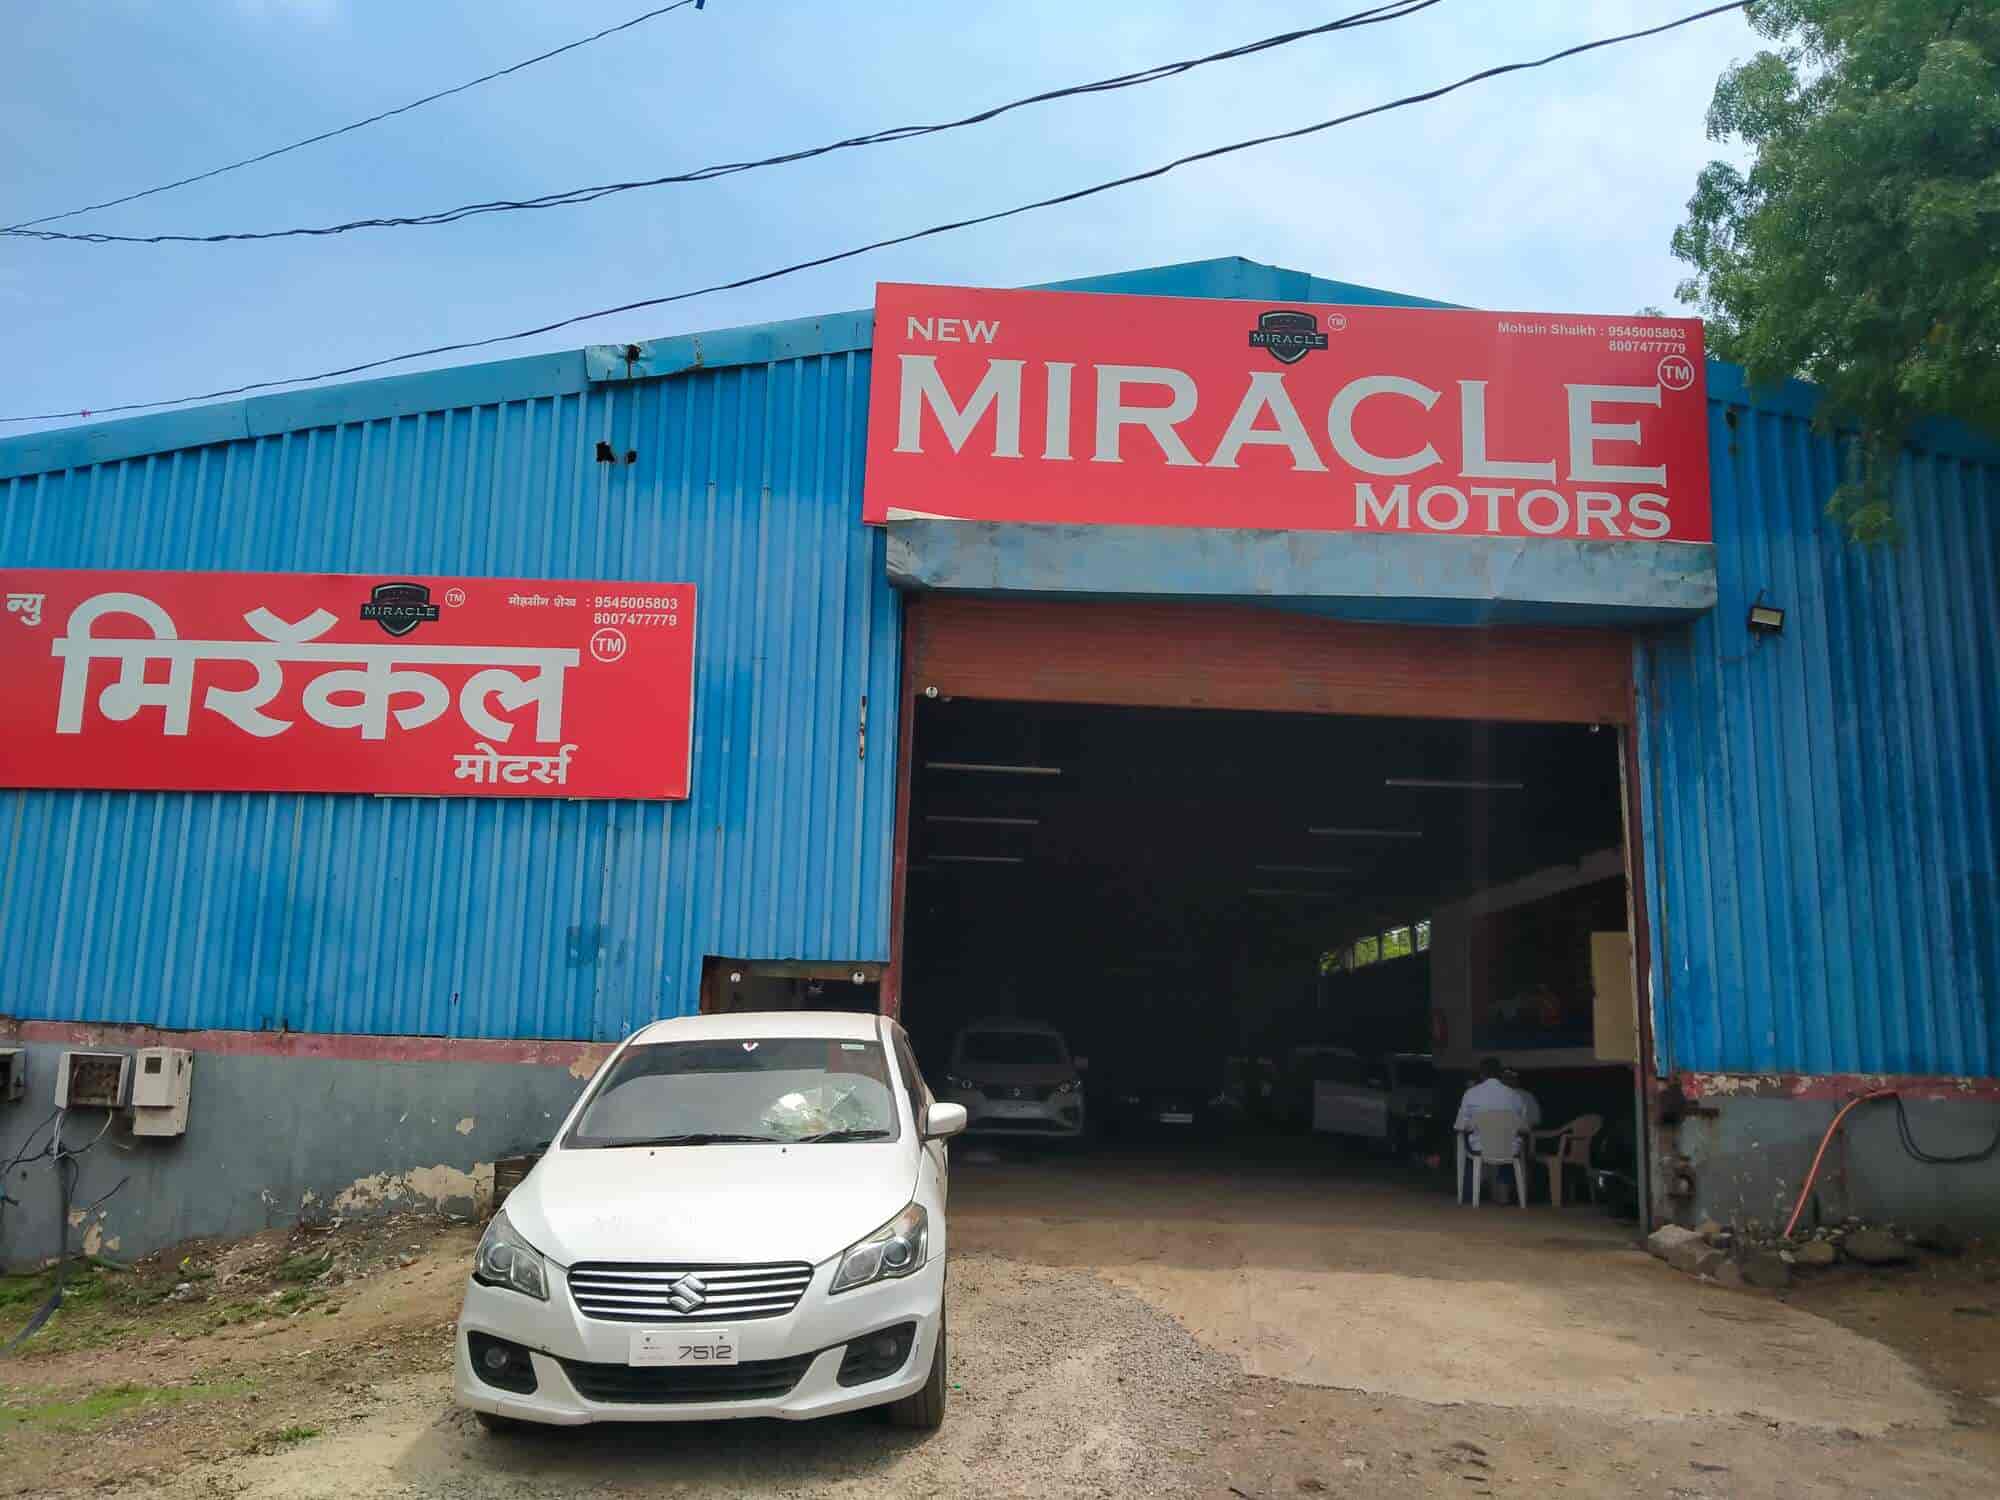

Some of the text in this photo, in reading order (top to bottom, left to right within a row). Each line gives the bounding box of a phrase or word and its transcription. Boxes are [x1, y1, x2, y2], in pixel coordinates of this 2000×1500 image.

[905, 316, 1001, 344] NEW
[1498, 322, 1547, 335] Mohsin
[1551, 324, 1596, 337] Shaikh
[1608, 326, 1686, 339] 9545005803
[1252, 333, 1326, 345] MIRACLE
[1609, 340, 1686, 353] 8007477779
[892, 353, 1668, 488] MIRACLE
[1352, 482, 1672, 538] MOTORS
[594, 596, 678, 609] 9545005803
[363, 606, 435, 617] MIRACLE
[594, 613, 678, 626] 8007477779
[51, 592, 580, 743] मिरॅकल
[453, 742, 579, 785] मोटर्स
[679, 1345, 731, 1360] 7512
